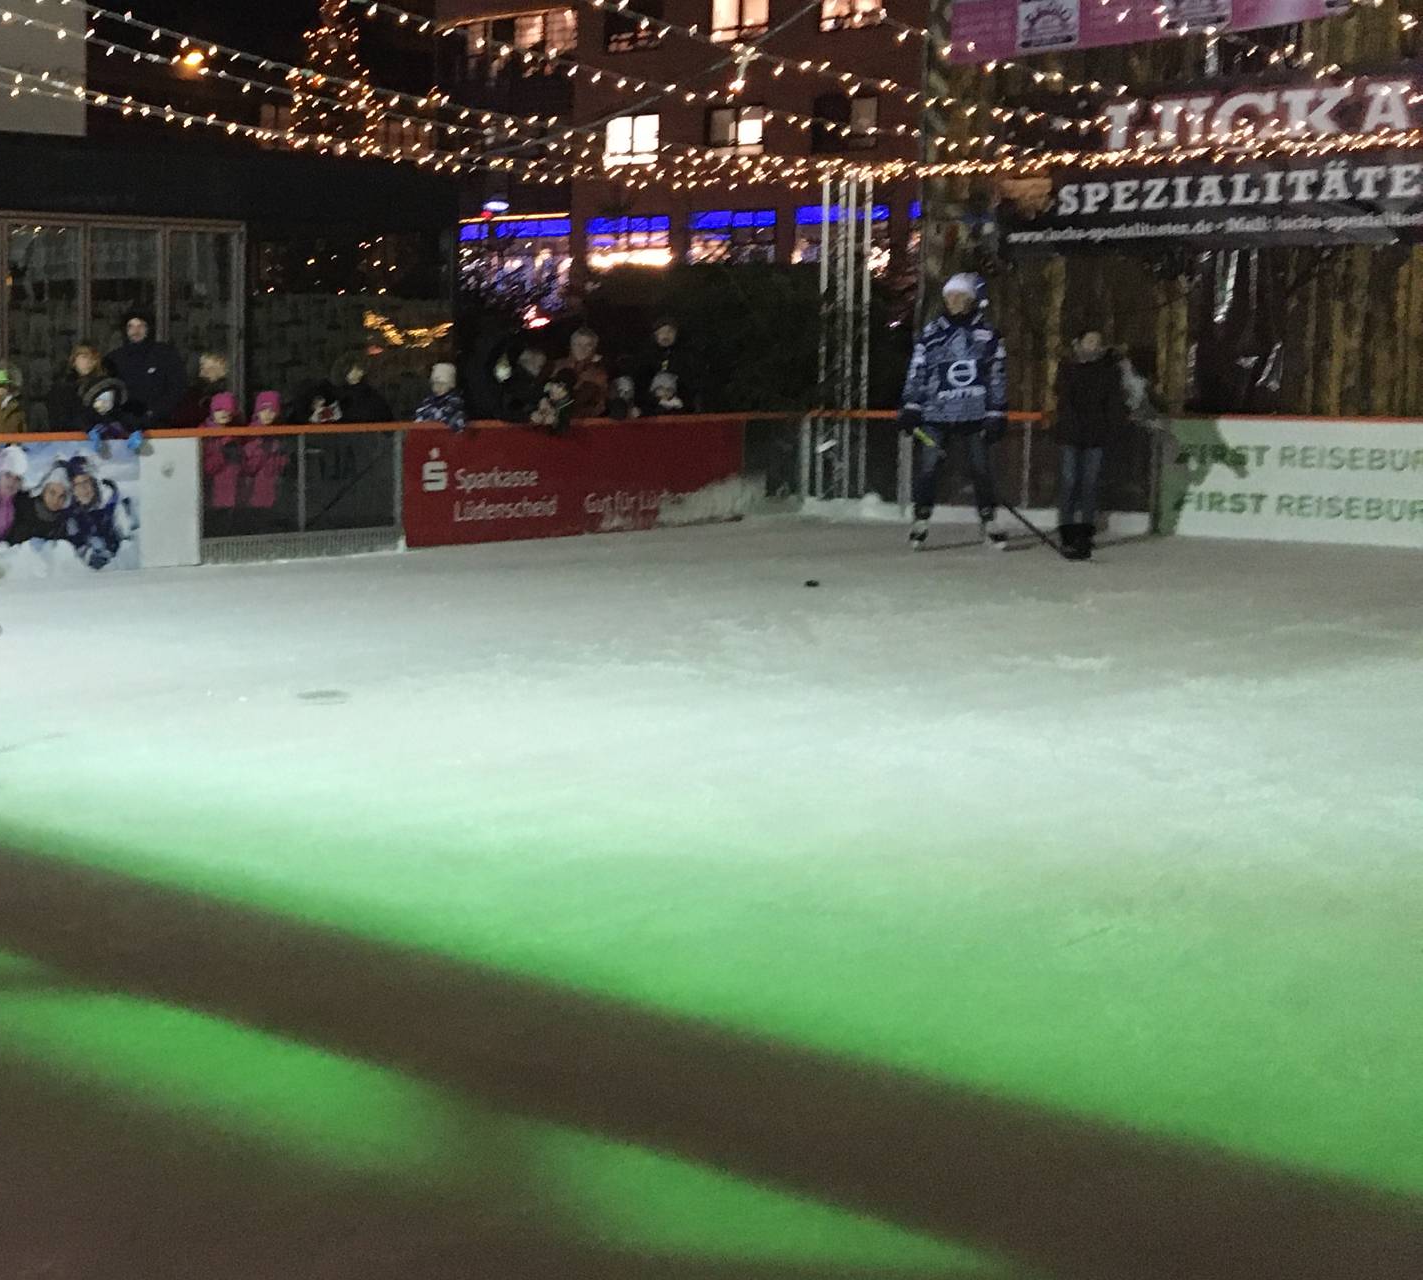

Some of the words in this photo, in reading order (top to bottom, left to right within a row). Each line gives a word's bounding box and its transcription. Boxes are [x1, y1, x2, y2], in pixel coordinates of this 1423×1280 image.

[1058, 160, 1423, 216] SPEZIALITÄTE
[455, 466, 539, 492] Sparkasse
[453, 495, 558, 523] Lüdenscheid
[1181, 491, 1268, 514] FIRST
